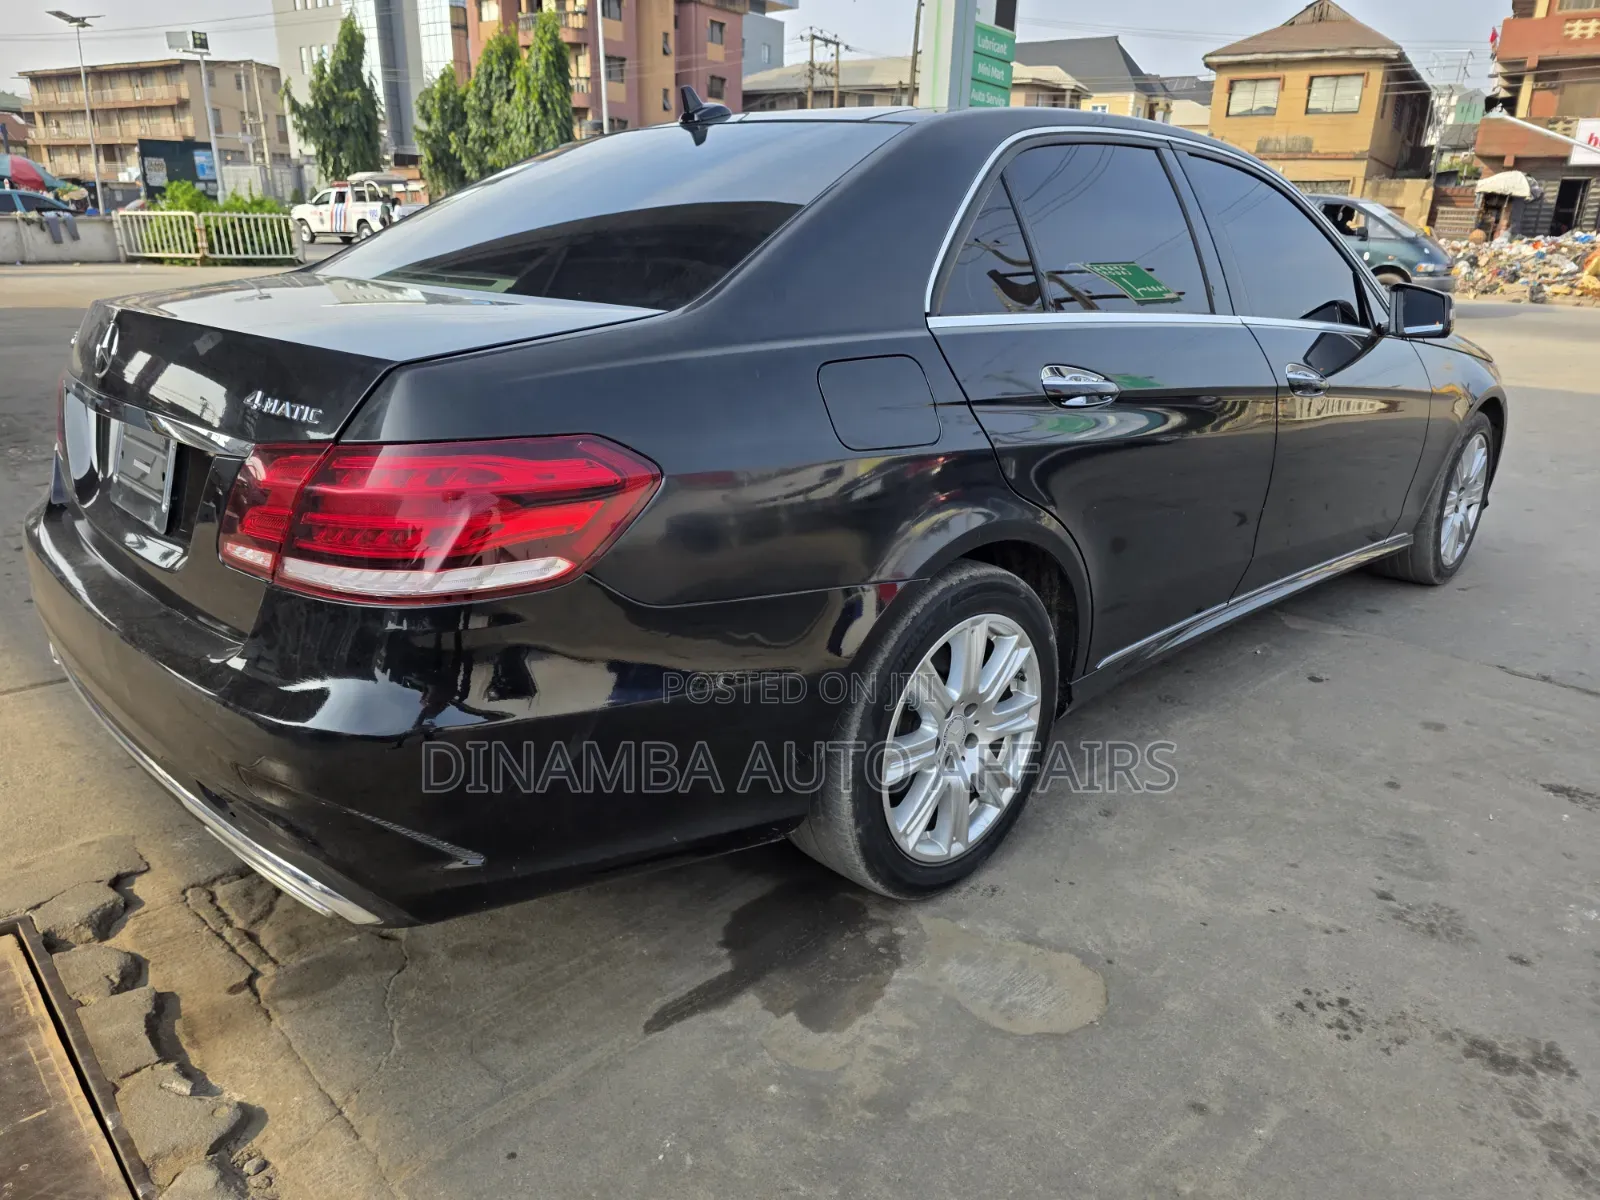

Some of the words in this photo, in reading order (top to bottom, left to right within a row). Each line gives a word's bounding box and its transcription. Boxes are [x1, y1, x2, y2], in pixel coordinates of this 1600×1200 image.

[977, 34, 1008, 56] Lubricant
[977, 62, 991, 77] Mini
[991, 65, 1005, 81] Mart
[970, 87, 985, 102] Auto
[243, 390, 323, 424] 4MATIC
